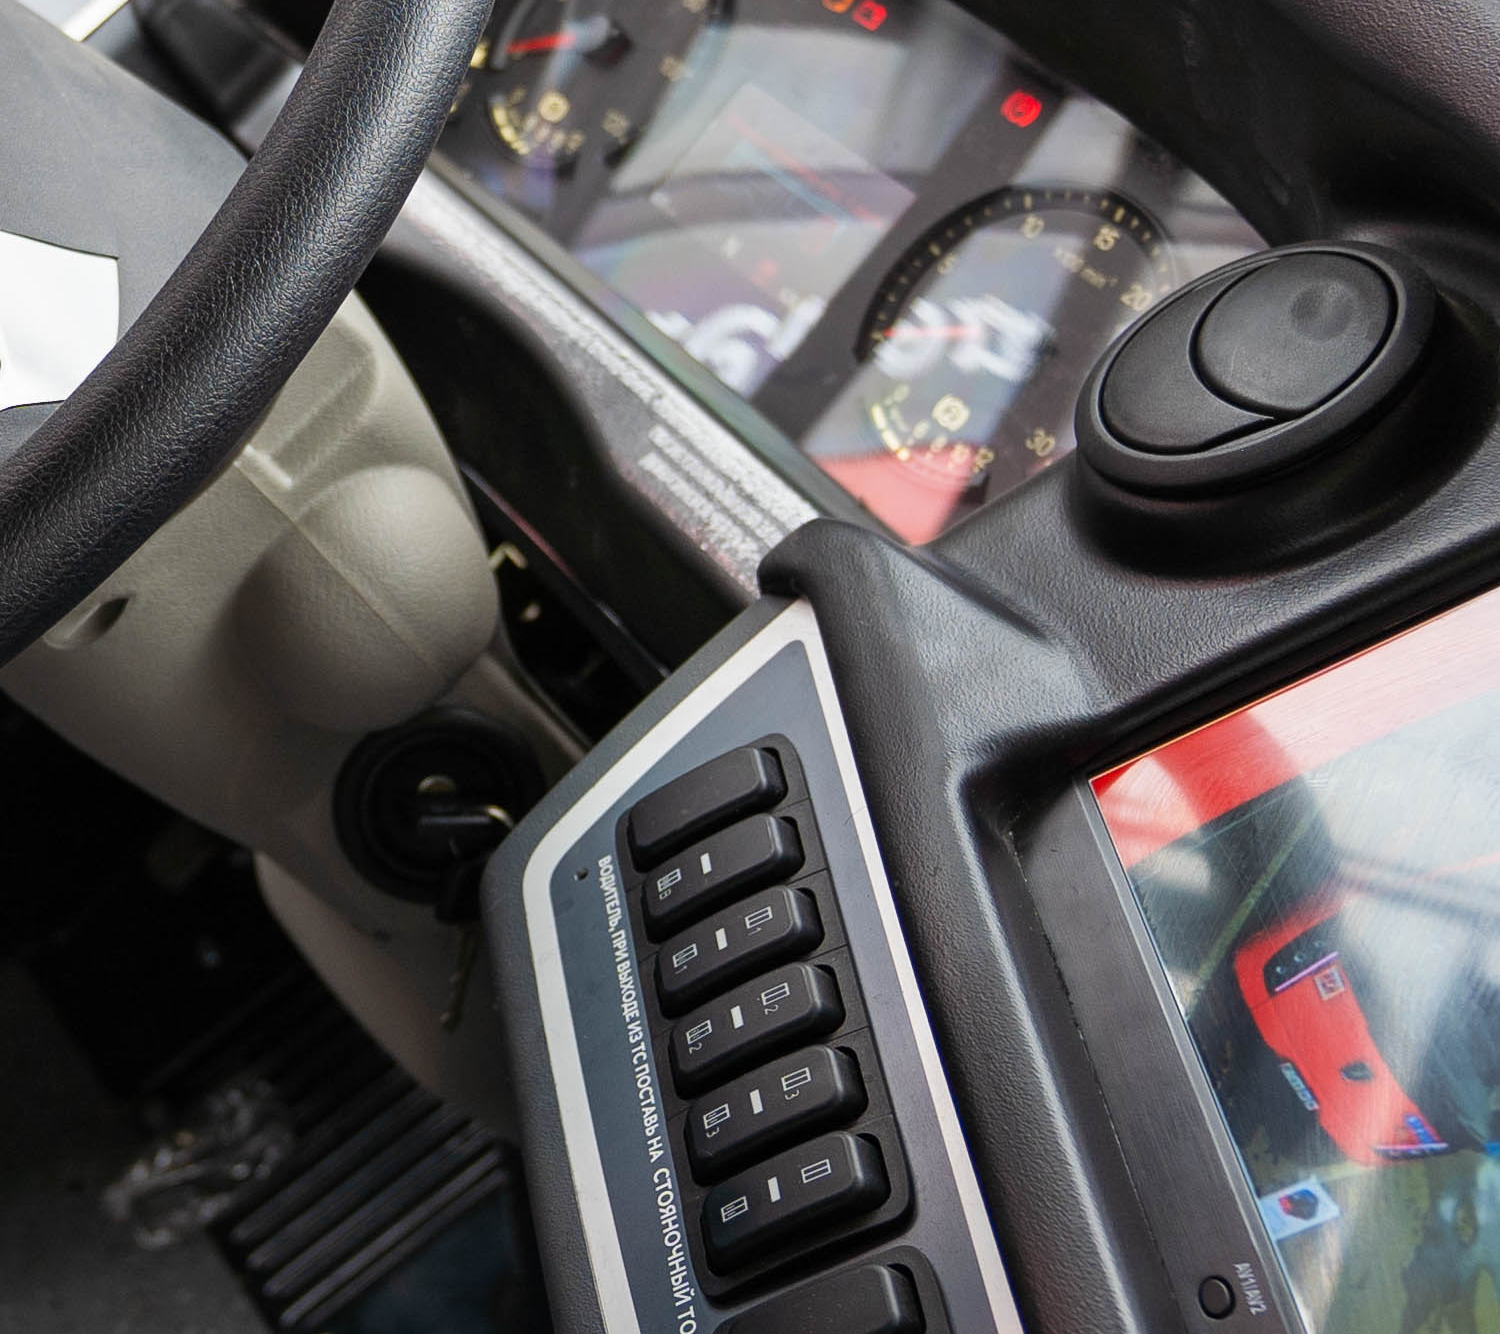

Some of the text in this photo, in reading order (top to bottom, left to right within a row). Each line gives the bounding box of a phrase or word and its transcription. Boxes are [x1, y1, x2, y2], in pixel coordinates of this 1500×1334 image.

[1118, 278, 1156, 314] 20
[1022, 423, 1060, 460] 30
[598, 855, 620, 931] ВОДИТЕЛЬ,
[610, 931, 627, 960] ПРИ
[615, 962, 639, 1021] ВЫХОДЕ
[625, 1022, 643, 1042] ИЗ
[631, 1044, 647, 1064] ТС
[633, 1065, 659, 1135] ПОСТАВЬ
[646, 1136, 661, 1163] НА
[652, 1168, 695, 1306] СТОЯНОЧНЫЙ
